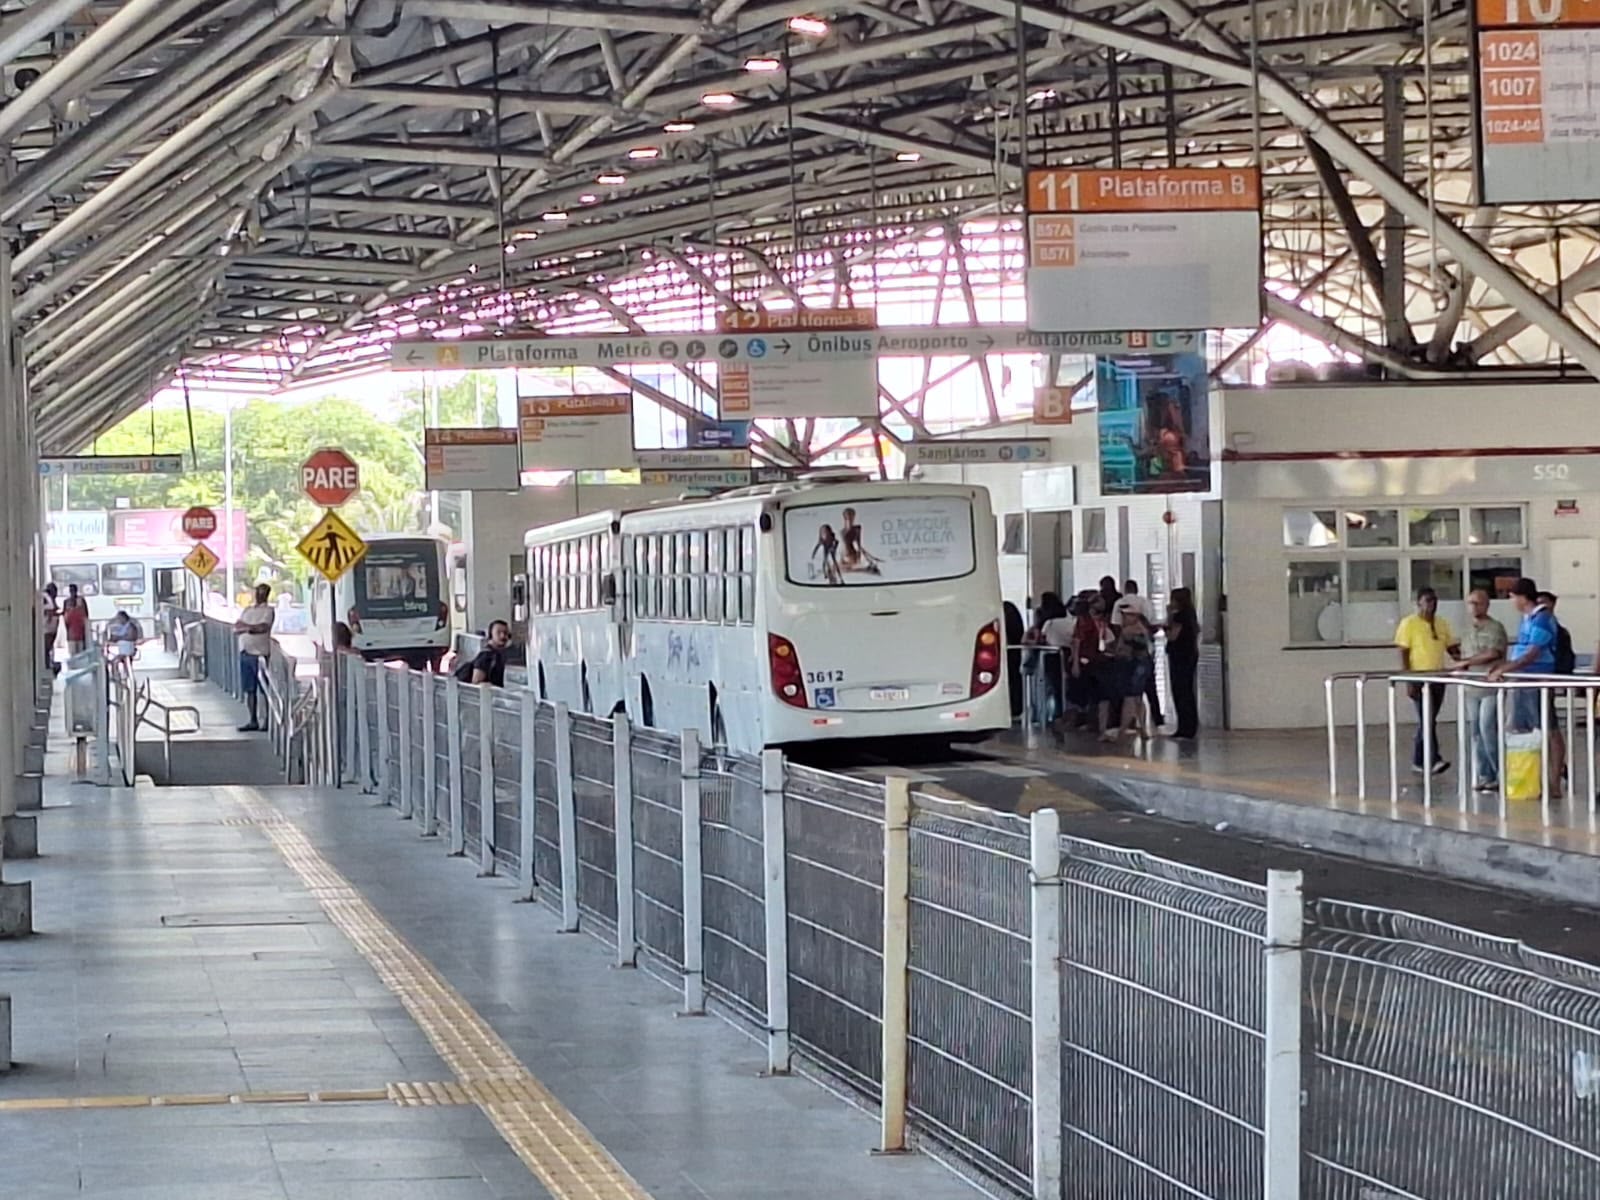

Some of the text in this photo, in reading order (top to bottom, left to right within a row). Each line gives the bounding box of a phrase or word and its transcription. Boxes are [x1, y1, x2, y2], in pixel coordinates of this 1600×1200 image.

[1487, 42, 1537, 61] 1024
[1489, 77, 1536, 96] 1007
[1038, 173, 1245, 210] 11 Plataforma B
[478, 344, 578, 361] Plataforma
[598, 342, 651, 359] Metrô
[807, 332, 872, 352] Ônibus
[877, 335, 969, 352] Aeroporto
[1016, 332, 1122, 346] Plataformas
[1132, 332, 1143, 346] B
[1046, 389, 1064, 418] B
[302, 467, 356, 489] PARE
[184, 517, 214, 530] PARE
[881, 519, 894, 532] O
[807, 670, 844, 683] 3612
